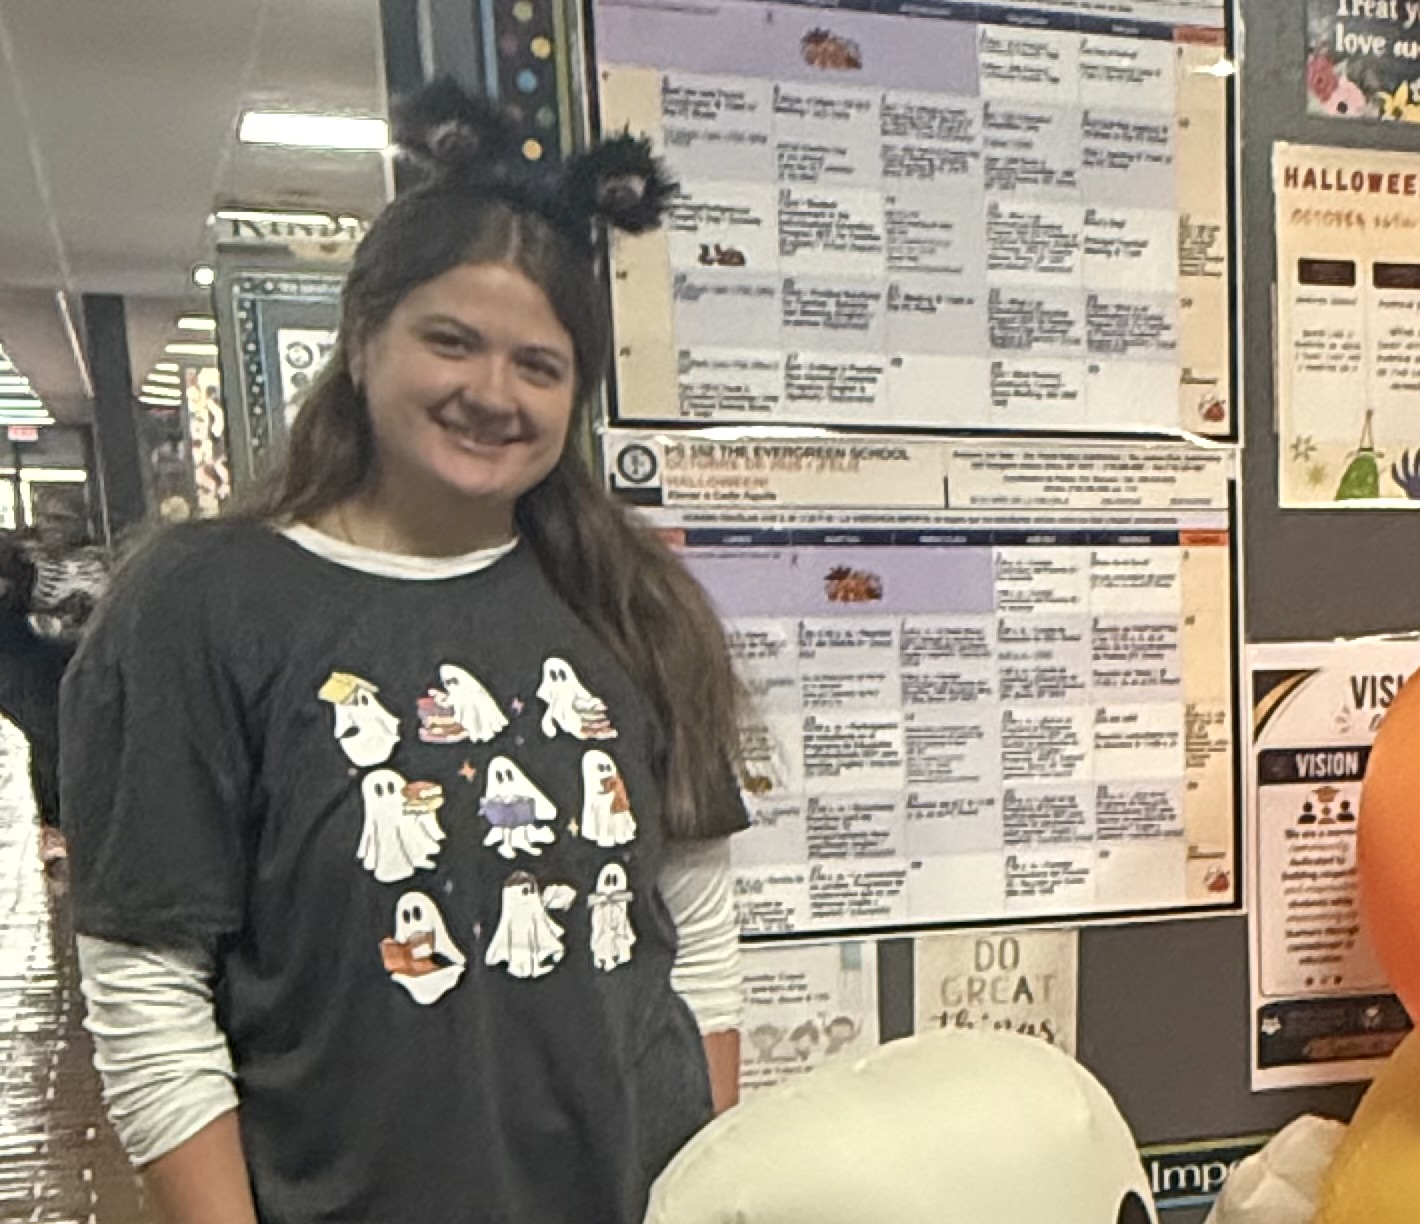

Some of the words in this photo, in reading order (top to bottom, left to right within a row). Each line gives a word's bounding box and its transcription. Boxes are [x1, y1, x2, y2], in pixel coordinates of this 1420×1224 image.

[1335, 21, 1387, 56] love
[1295, 751, 1359, 778] VISION
[974, 936, 1020, 973] DO
[941, 974, 1057, 1007] GREAT
[1151, 1160, 1241, 1193] Imp
